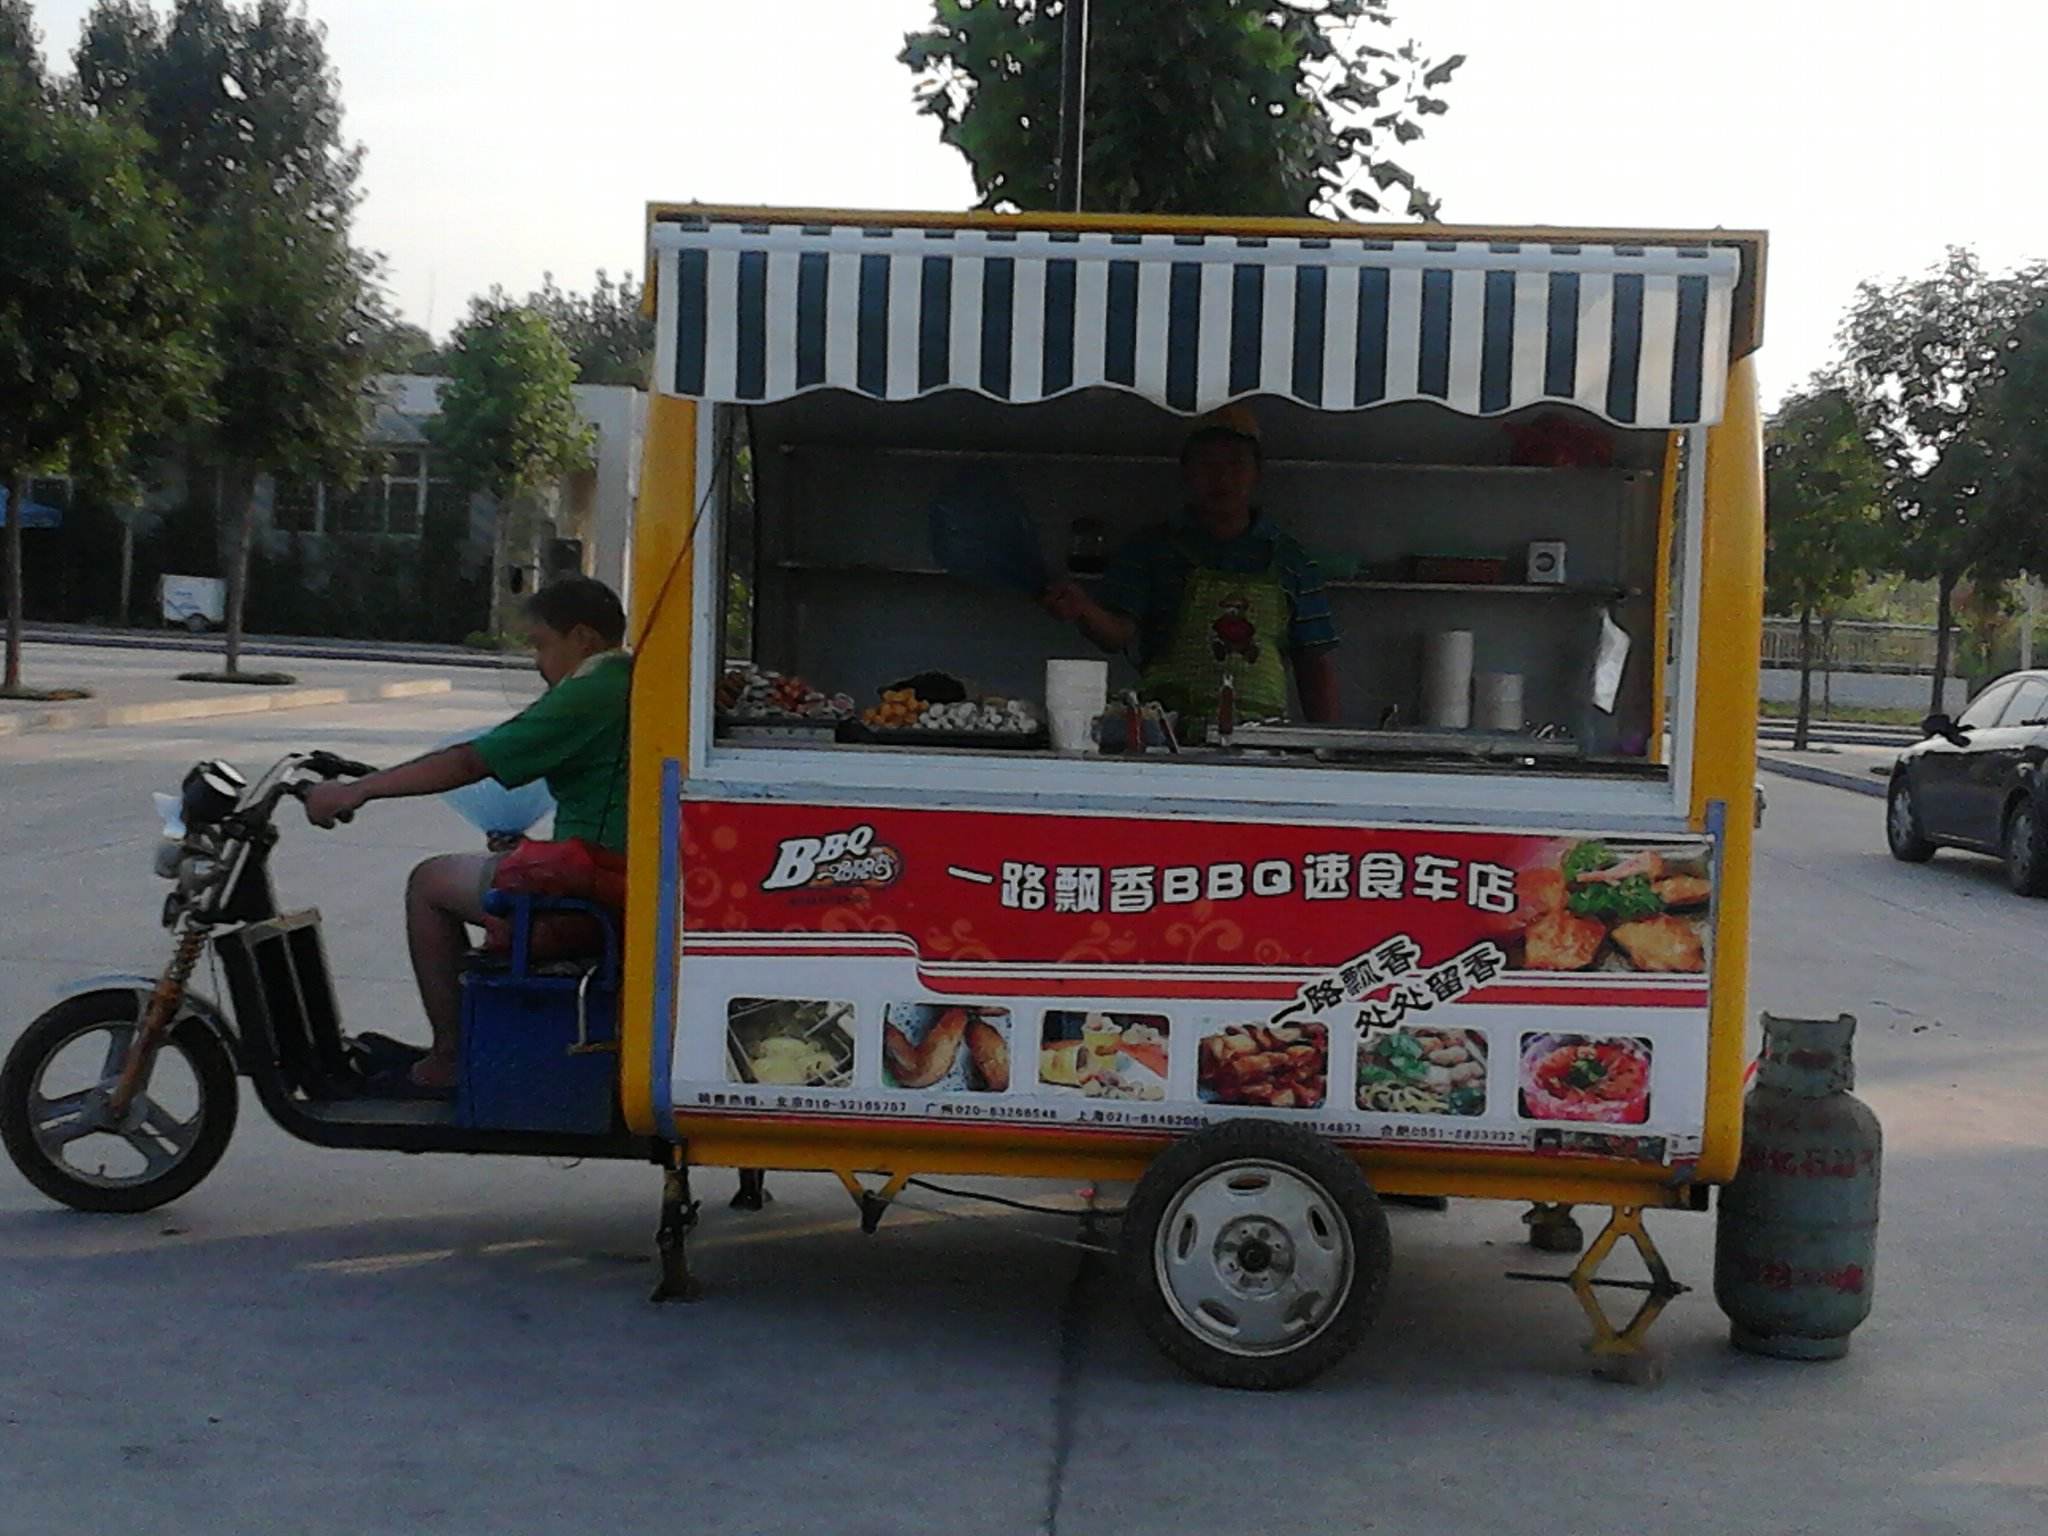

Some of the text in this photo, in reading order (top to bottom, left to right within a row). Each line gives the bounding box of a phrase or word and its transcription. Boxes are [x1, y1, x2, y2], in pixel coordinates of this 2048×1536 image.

[762, 825, 874, 890] BBQ
[947, 852, 1516, 914] 一路飘香BBQ速食车店
[1270, 938, 1418, 1025] 一路飘香
[1354, 946, 1502, 1039] 处处留香
